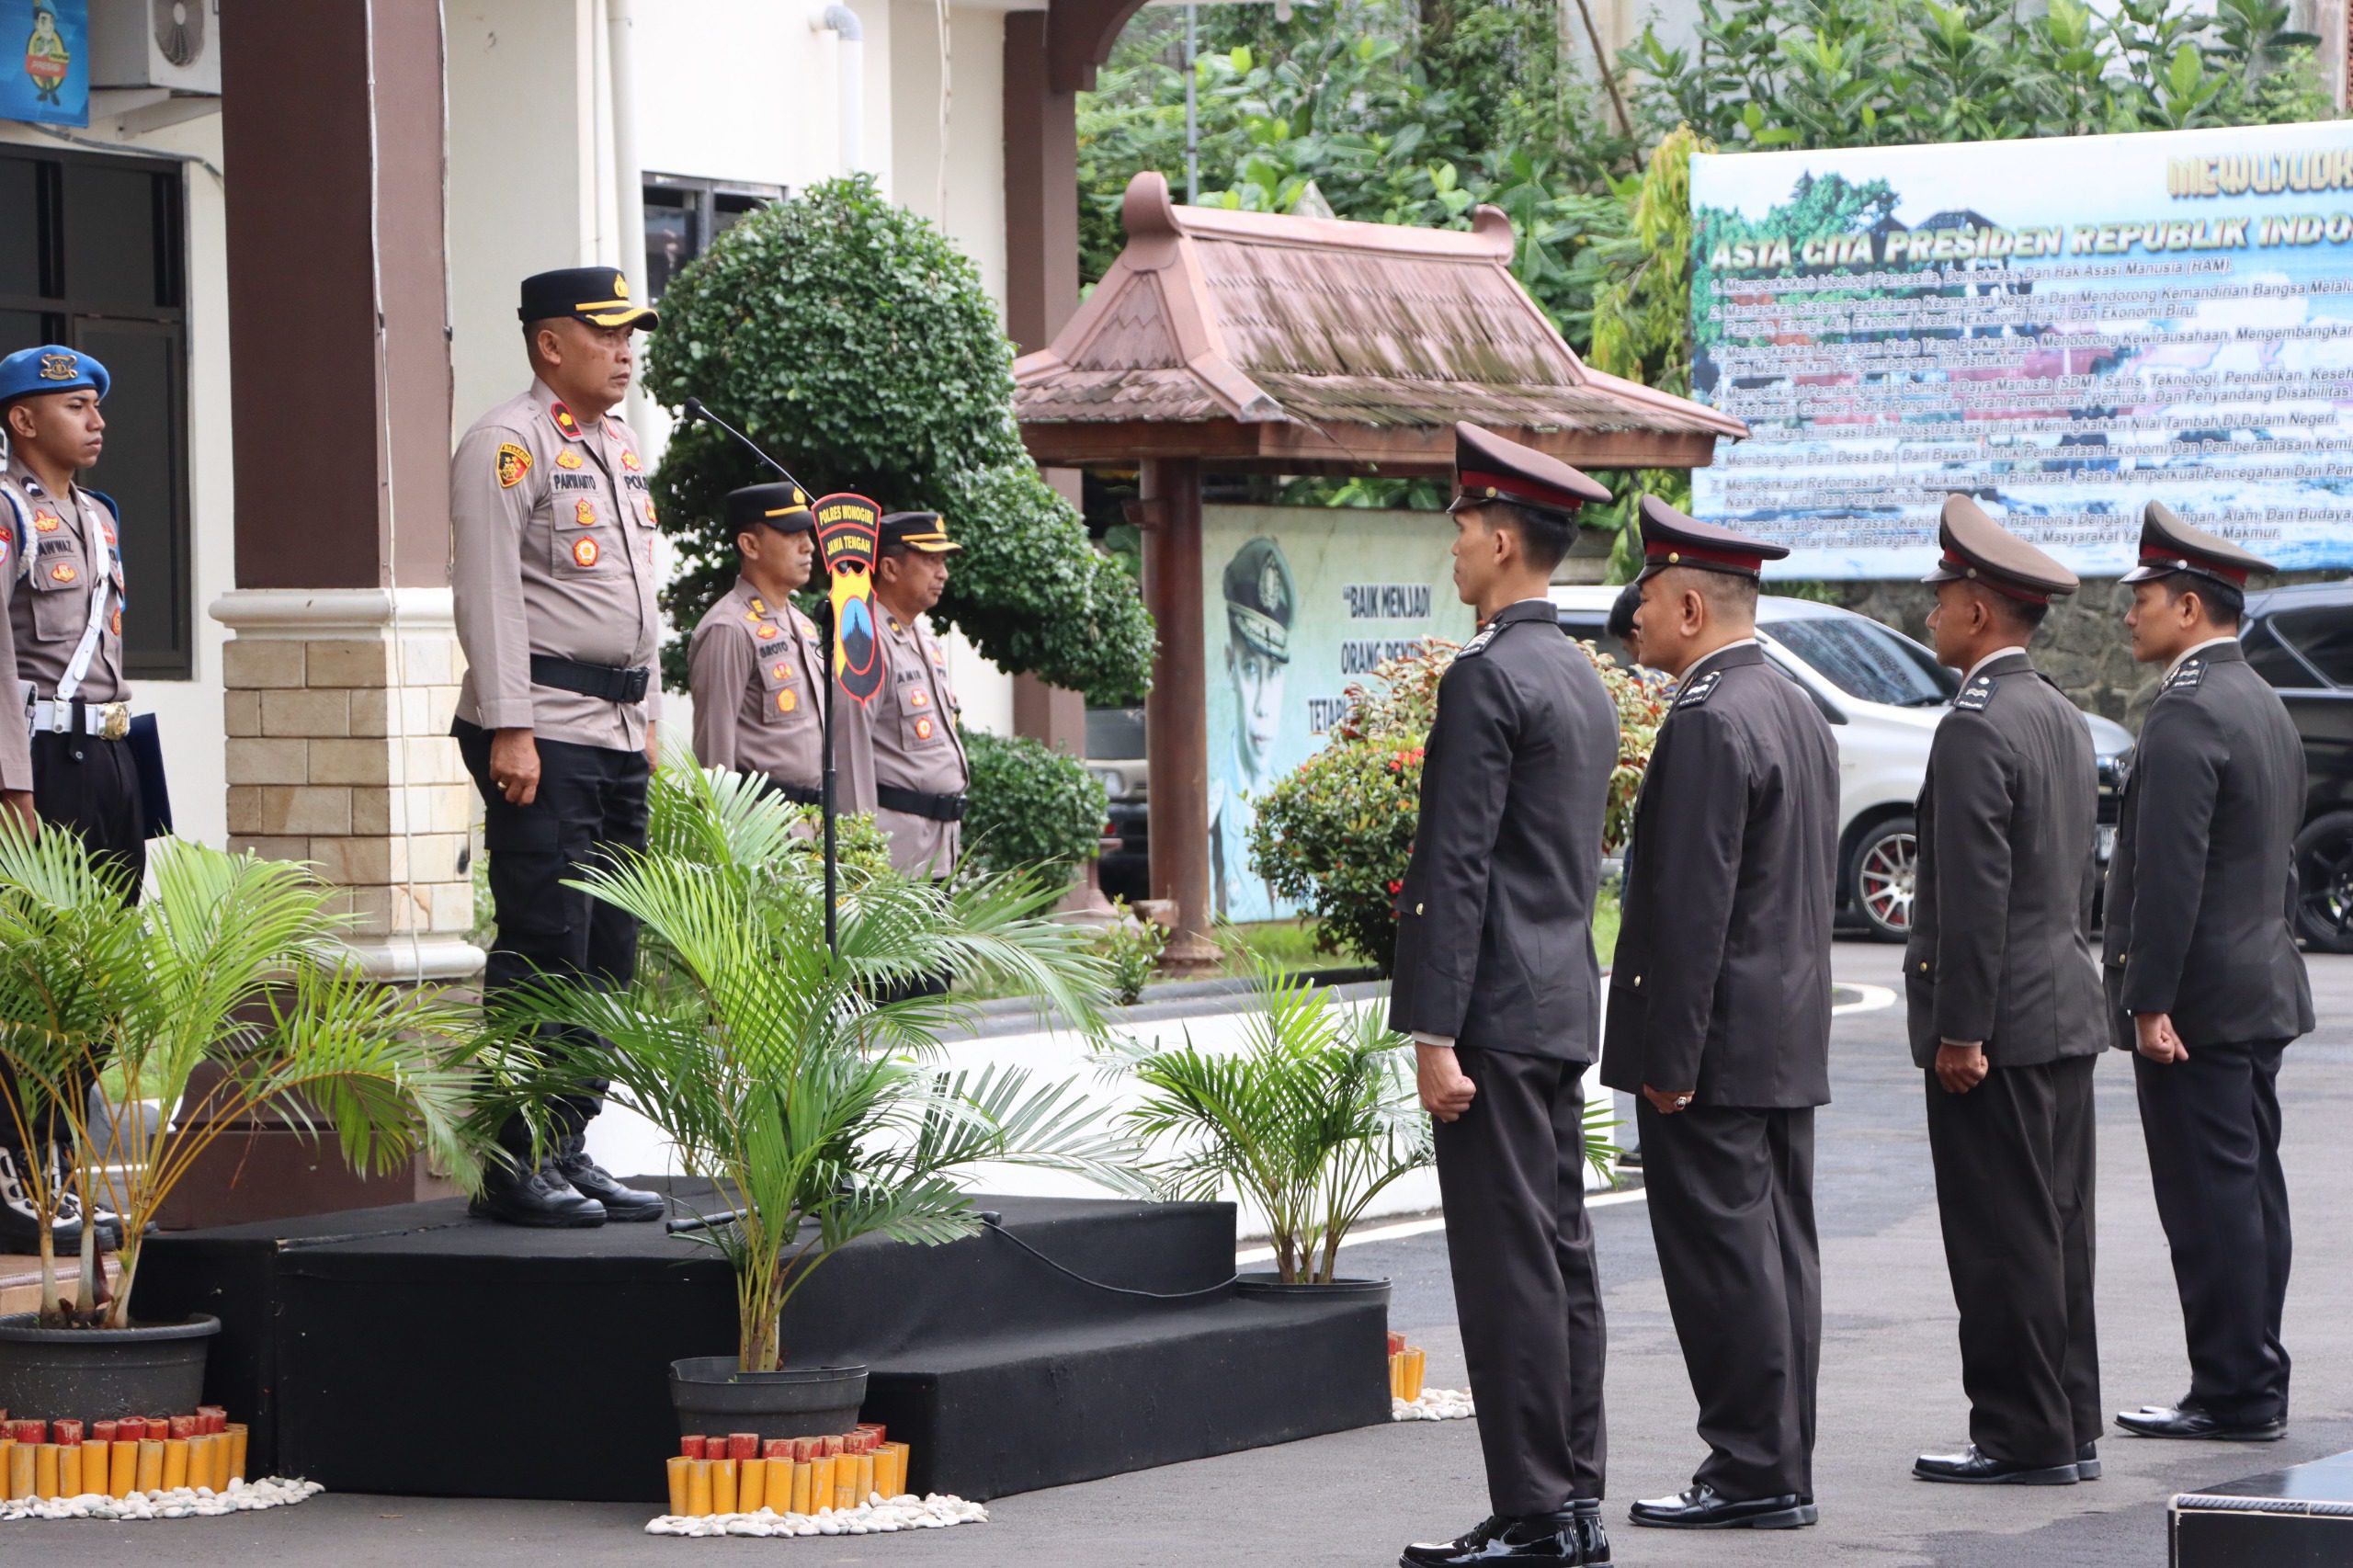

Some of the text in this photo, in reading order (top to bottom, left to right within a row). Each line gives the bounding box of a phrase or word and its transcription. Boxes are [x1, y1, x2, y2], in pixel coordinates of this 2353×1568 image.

[1711, 235, 1792, 267] ASTA
[1800, 232, 1875, 264] CITA
[1883, 225, 2063, 261] PRESIDEN
[2070, 218, 2250, 254] REPUBLIK
[1724, 275, 1816, 294] Memperkokoh
[2024, 265, 2051, 279] Dan
[2054, 264, 2079, 278] Hak
[2084, 262, 2121, 278] Asasi
[2124, 259, 2183, 276] Manusia
[1725, 302, 1792, 319] Mantapkan
[1796, 300, 1842, 315] Sistem
[1844, 297, 1921, 312] Pertahanan
[1923, 293, 1995, 310] Keamanan
[1999, 291, 2045, 309] Negara
[2049, 290, 2075, 304] Dan
[2079, 287, 2157, 303] Mendorong
[2161, 282, 2249, 300] Kemandirian
[2253, 280, 2305, 298] Bangsa
[1852, 314, 1913, 330] Ekonomi
[2070, 307, 2097, 322] Dan
[2101, 305, 2161, 320] Ekonomi
[1726, 343, 1813, 360] Meningkatkan
[1815, 340, 1882, 358] Lapangan
[1884, 339, 1921, 355] Kerja
[1922, 337, 1957, 354] Yang
[2041, 332, 2118, 347] Mendorong
[1725, 363, 1751, 377] Dan
[1836, 356, 1938, 374] Pengembangan
[1725, 385, 1807, 402] Memperkuat
[1808, 381, 1903, 398] Pembangunan
[1904, 380, 1957, 393] Sumber
[1959, 378, 1993, 394] Daya
[1995, 376, 2051, 391] Manusia
[1853, 398, 1889, 413] Serta
[1892, 396, 1962, 413] Penguatan
[1965, 394, 2006, 409] Peran
[2154, 389, 2182, 403] Dan
[2185, 386, 2271, 403] Penyandang
[1865, 425, 1892, 437] Dan
[1989, 421, 2029, 434] Untuk
[2032, 417, 2127, 434] Meningkatkan
[2131, 416, 2160, 429] Nilai
[2165, 415, 2219, 428] Tambah
[2241, 413, 2285, 426] Dalam
[1725, 451, 1807, 467] Membangun
[1808, 451, 1835, 464] Dari
[1837, 450, 1870, 463] Desa
[1873, 449, 1899, 462] Dan
[1902, 449, 1931, 461] Dari
[1932, 448, 1977, 461] Bawah
[1980, 446, 2022, 460] Untuk
[2024, 444, 2106, 459] Pemerataan
[2107, 442, 2167, 457] Ekonomi
[2171, 441, 2200, 455] Dan
[2202, 438, 2311, 454] Pemberantasan
[2315, 437, 2353, 450] Kemi
[553, 473, 597, 491] PARWANTO
[1724, 478, 1805, 494] Memperkuat
[1807, 476, 1874, 489] Reformasi
[1979, 472, 2006, 485] Dan
[2076, 470, 2112, 483] Serta
[2115, 467, 2200, 483] Memperkuat
[2203, 464, 2294, 481] Pencegahan
[2294, 464, 2322, 476] Dan
[1814, 491, 1842, 506] Dan
[819, 505, 874, 527] POLRES WONOGIRI
[2008, 513, 2075, 527] Harmonis
[2077, 511, 2131, 528] Dengan
[2266, 508, 2294, 522] Dan
[827, 536, 871, 556] JAWA TENGAH
[1825, 534, 1861, 547] Umat
[1862, 532, 1928, 548] Beragama
[2042, 528, 2120, 545] Masyarakat
[1381, 585, 1430, 618] MENJADI
